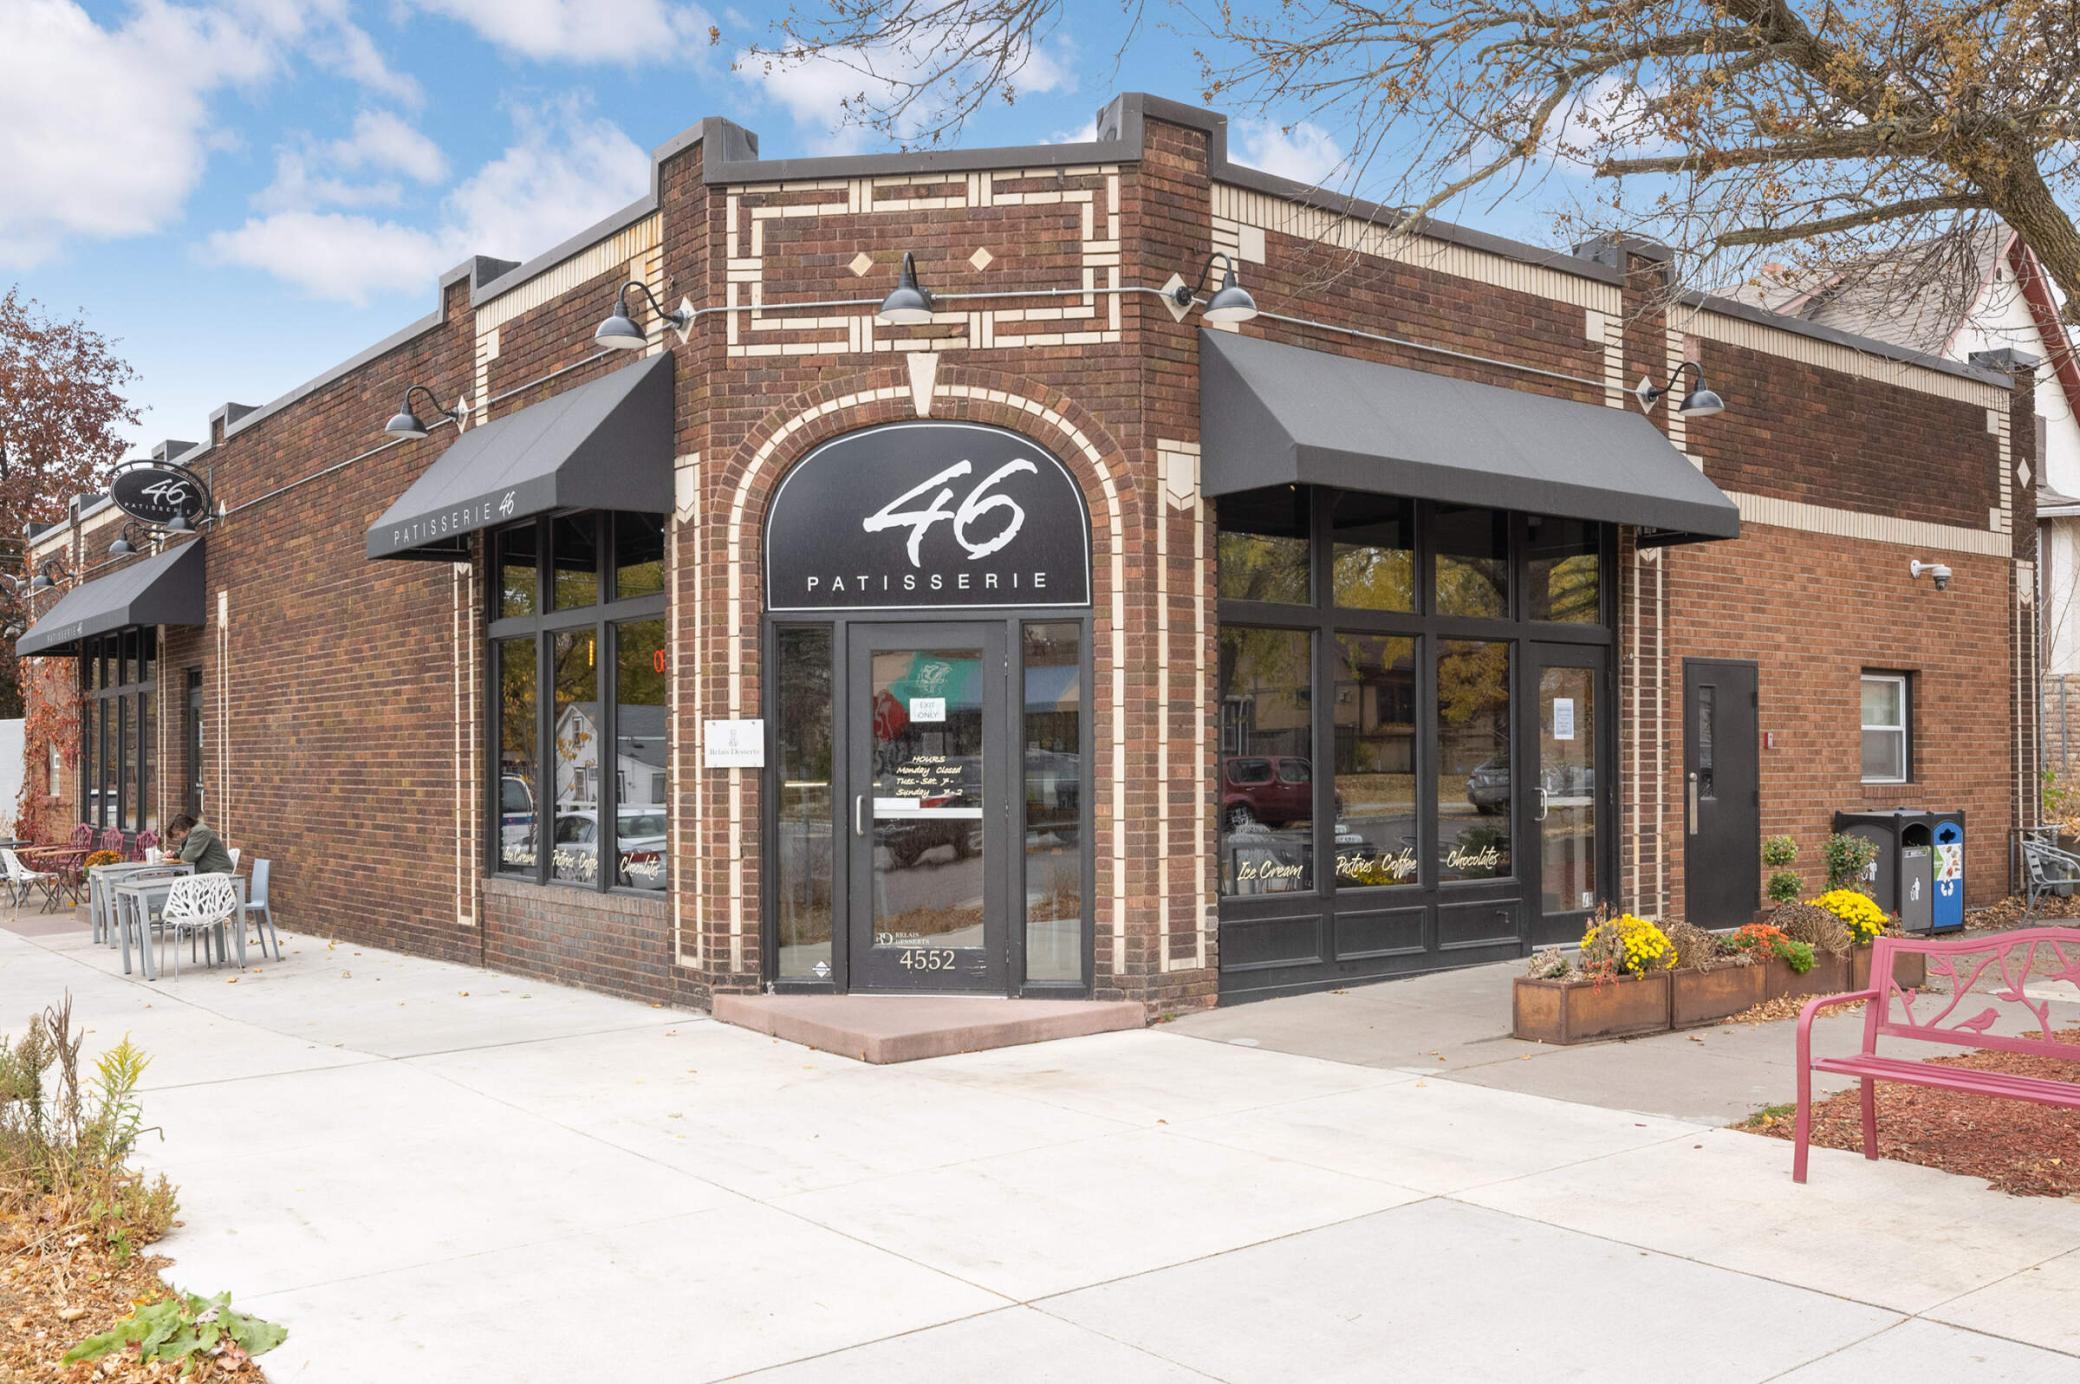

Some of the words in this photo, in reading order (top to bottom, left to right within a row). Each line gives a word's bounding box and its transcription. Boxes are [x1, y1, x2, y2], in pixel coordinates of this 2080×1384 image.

[141, 478, 190, 505] 46
[124, 502, 191, 515] PATISSERE
[394, 502, 491, 545] PATISSERIE
[499, 490, 516, 518] 46
[862, 458, 1038, 568] 46
[807, 572, 1046, 591] PATISSERIE
[896, 766, 930, 777] Monday
[936, 766, 962, 774] Closed
[896, 788, 930, 799] Sunday
[503, 846, 514, 861] Ice
[514, 848, 536, 866] Cream
[1335, 853, 1375, 878] Pastries
[1381, 847, 1417, 879] Coffee
[1446, 845, 1500, 870] Chocolates
[619, 853, 660, 880] Chocolates
[1237, 861, 1257, 880] Ice
[1260, 860, 1303, 879] Cream
[900, 950, 956, 970] 4552
